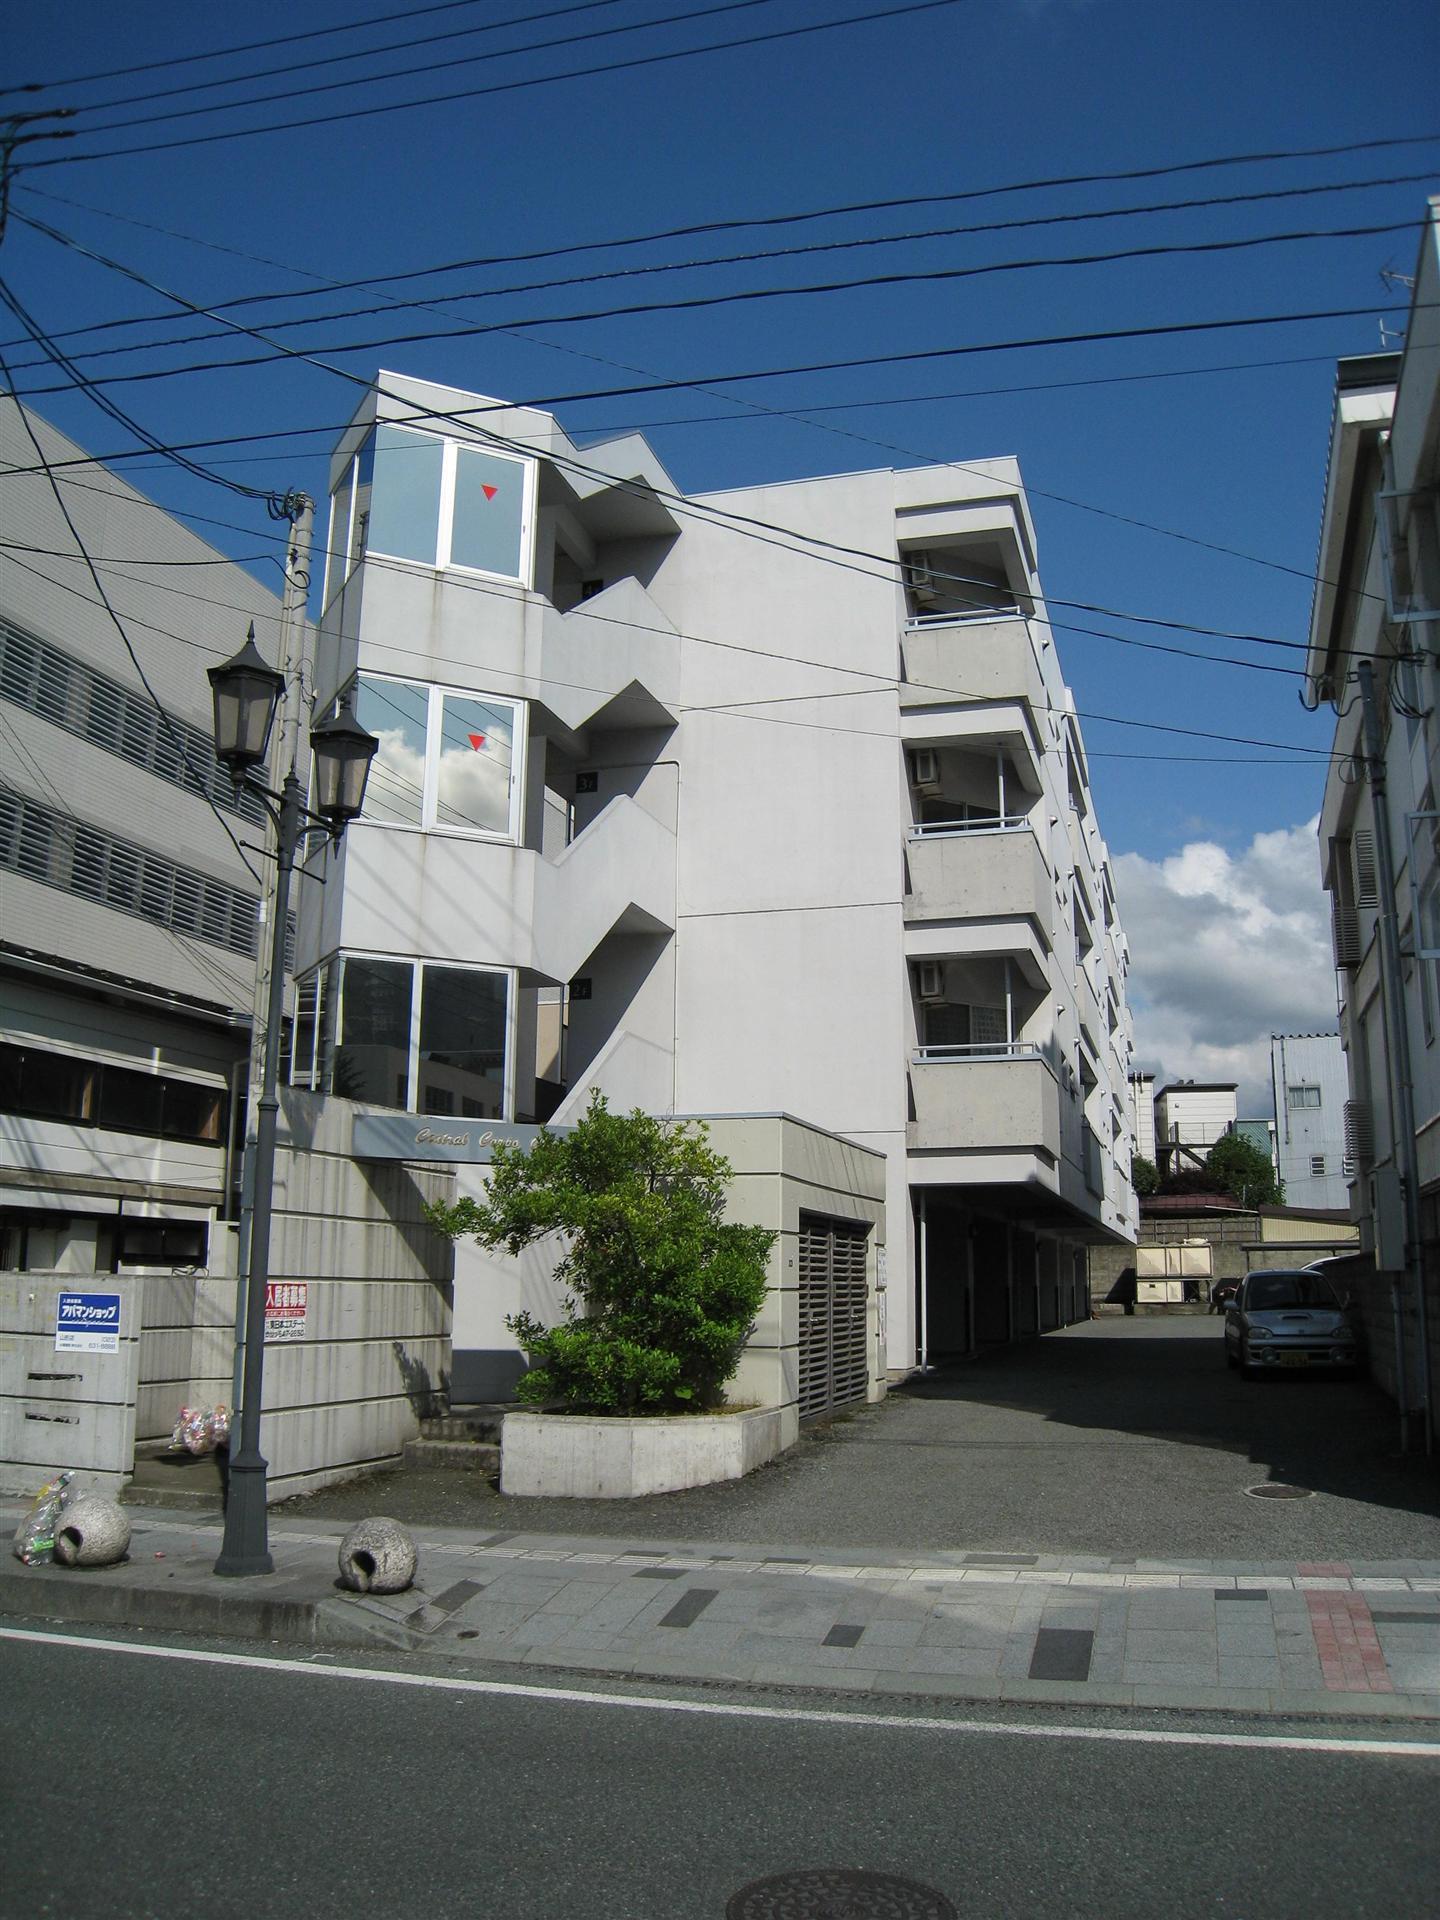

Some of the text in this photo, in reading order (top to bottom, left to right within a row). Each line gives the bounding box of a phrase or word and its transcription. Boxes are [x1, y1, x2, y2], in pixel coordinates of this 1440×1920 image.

[415, 1127, 470, 1146] Central
[266, 1285, 306, 1308] 入居者募集
[61, 1304, 117, 1319] アパマンショップ
